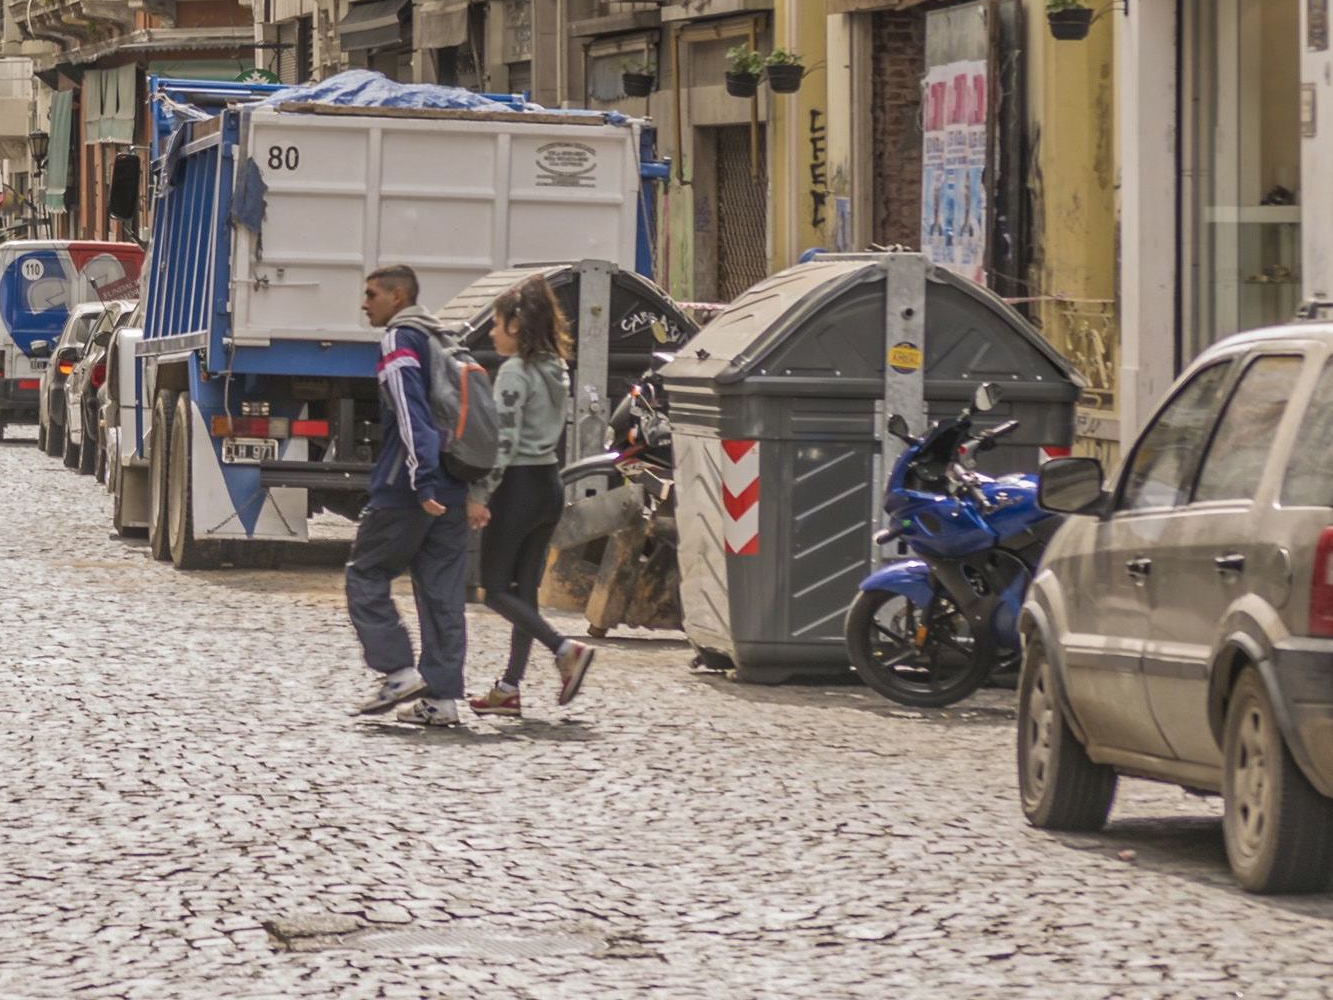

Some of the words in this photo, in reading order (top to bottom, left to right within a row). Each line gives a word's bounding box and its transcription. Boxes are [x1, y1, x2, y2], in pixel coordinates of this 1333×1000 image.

[267, 145, 300, 170] 80
[25, 263, 41, 277] 110
[252, 445, 273, 460] 971
